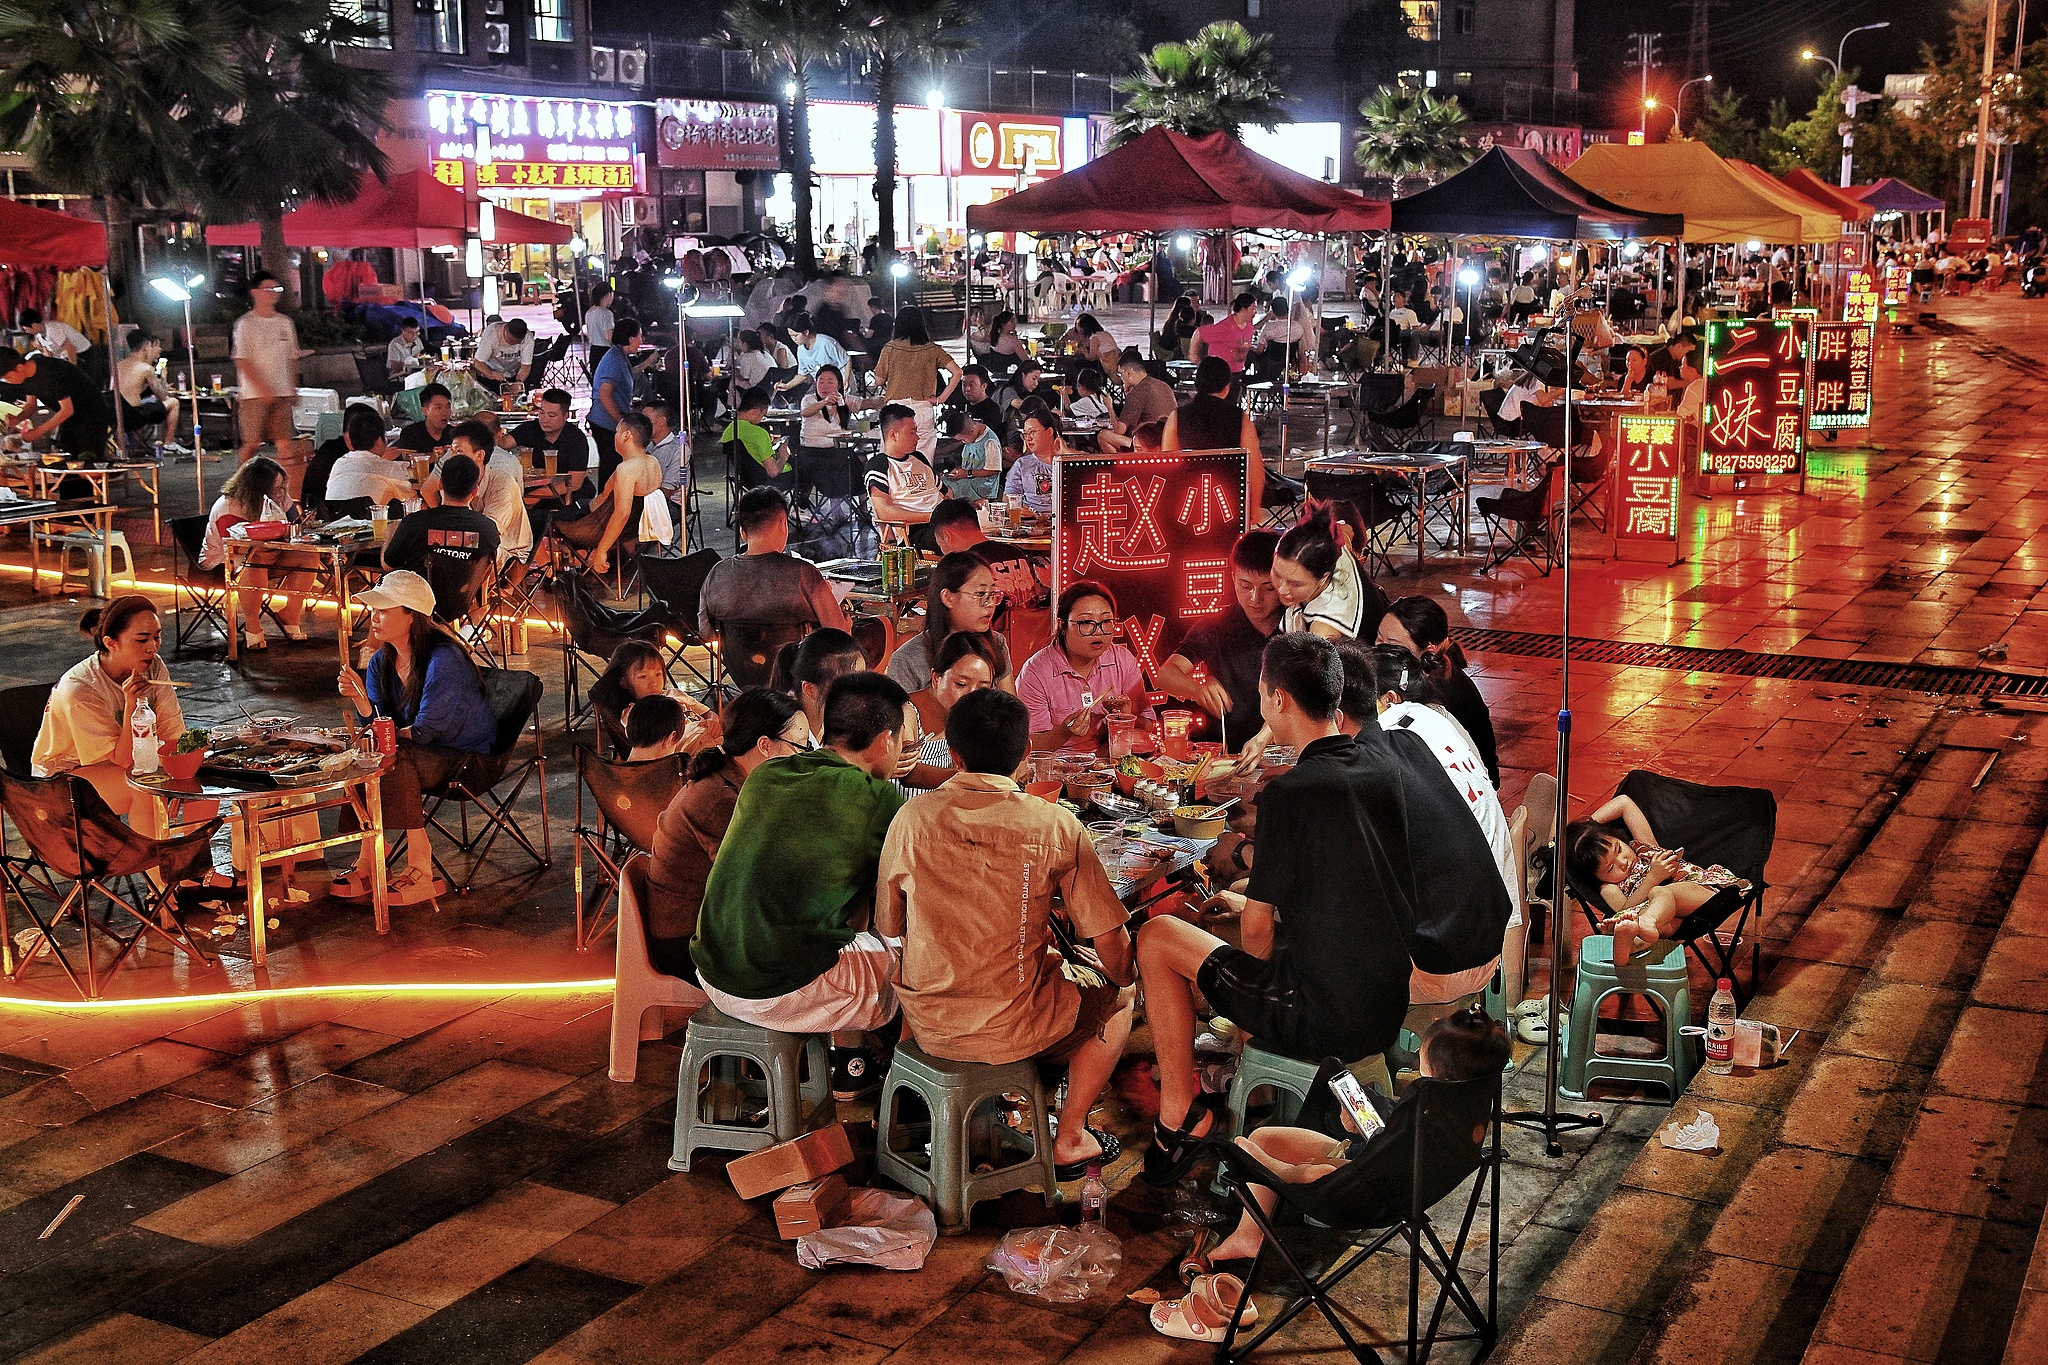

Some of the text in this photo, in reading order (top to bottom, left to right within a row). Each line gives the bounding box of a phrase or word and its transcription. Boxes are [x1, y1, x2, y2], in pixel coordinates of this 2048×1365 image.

[1710, 327, 1771, 448] 二妹
[1773, 325, 1802, 451] 小豆腐
[1815, 330, 1847, 412] 胖胖
[1848, 328, 1870, 411] 爆浆豆腐
[1626, 445, 1670, 534] 小豆腐
[1707, 454, 1796, 470] 18275598250
[433, 547, 472, 560] ICTORY
[1177, 473, 1234, 690] 小豆
